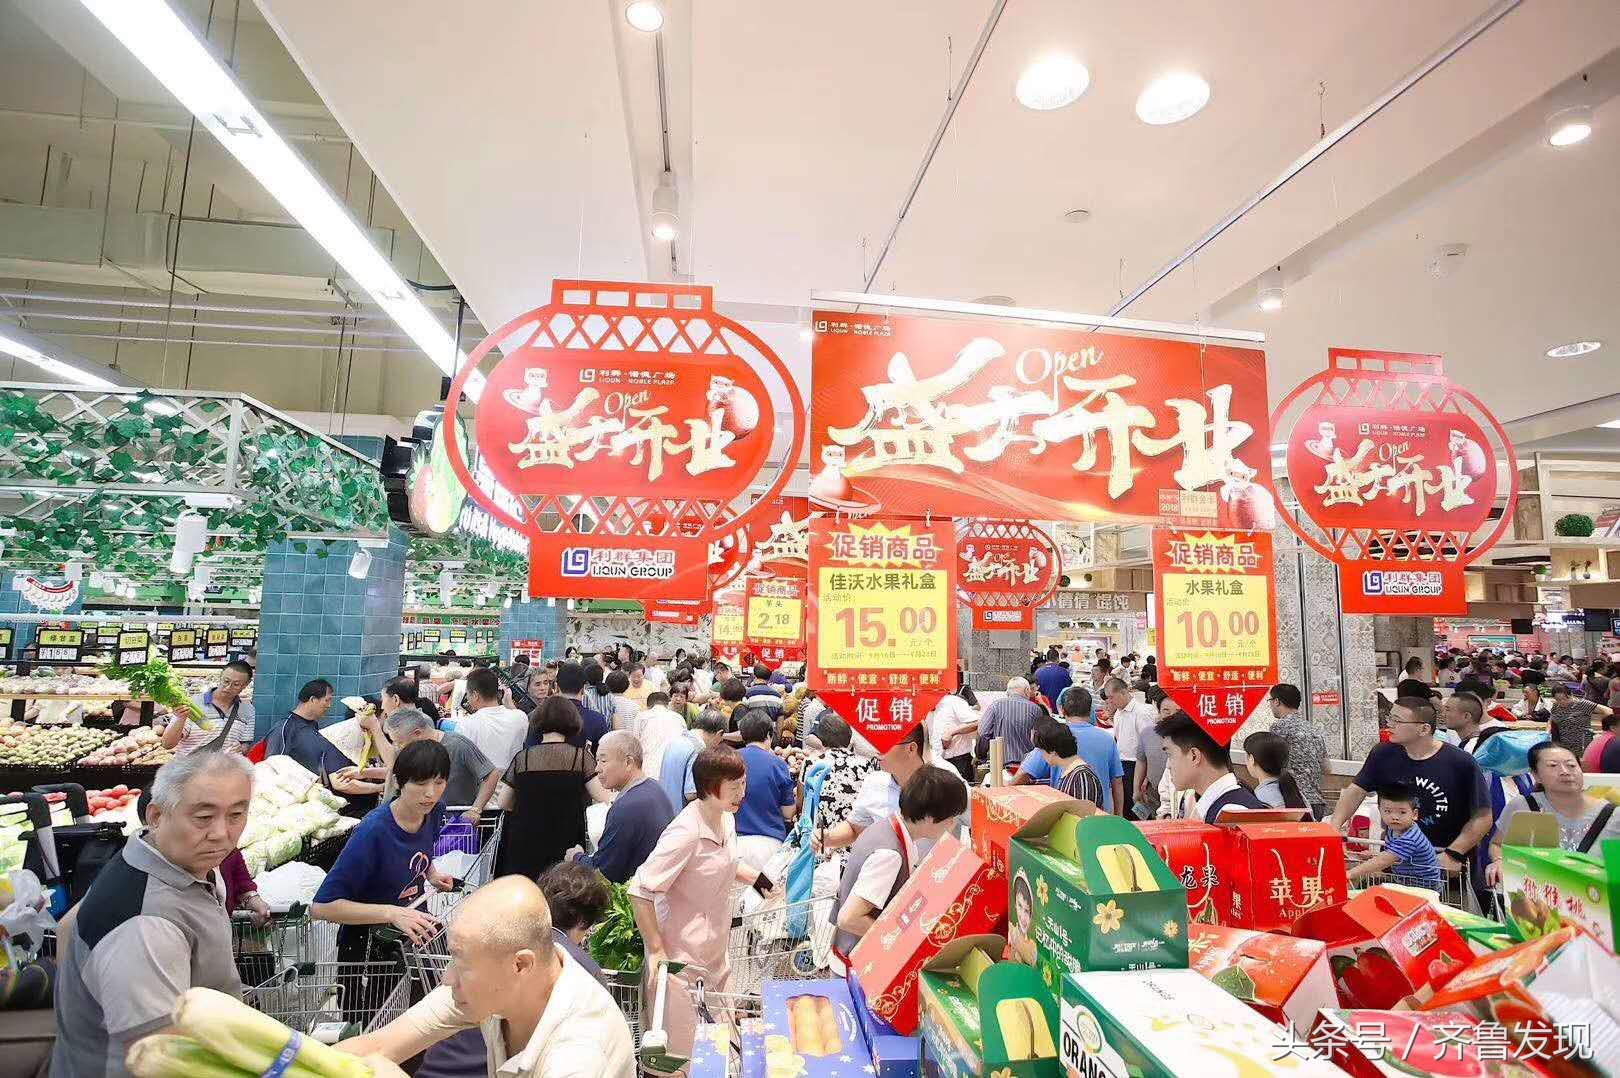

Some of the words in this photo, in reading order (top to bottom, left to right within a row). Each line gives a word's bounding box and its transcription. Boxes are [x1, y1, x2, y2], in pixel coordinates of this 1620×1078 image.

[1015, 344, 1104, 414] Open
[604, 389, 649, 427] Open
[828, 336, 1254, 500] 盛大开业
[508, 387, 737, 482] 盛大开业
[1314, 438, 1475, 516] 盛大开业
[832, 534, 937, 560] 促销商品
[1173, 542, 1257, 567] 促销商品
[593, 565, 627, 576] LIQUN
[630, 566, 673, 577] GROUP
[829, 573, 937, 590] 佳沃水果礼盒
[1186, 580, 1245, 596] 水果礼盒
[1411, 585, 1442, 595] GROUP
[757, 613, 790, 630] 2.18
[856, 698, 913, 723] 促销
[1198, 693, 1244, 717] 促销
[1415, 776, 1448, 812] WHITE
[1269, 875, 1325, 907] 苹果
